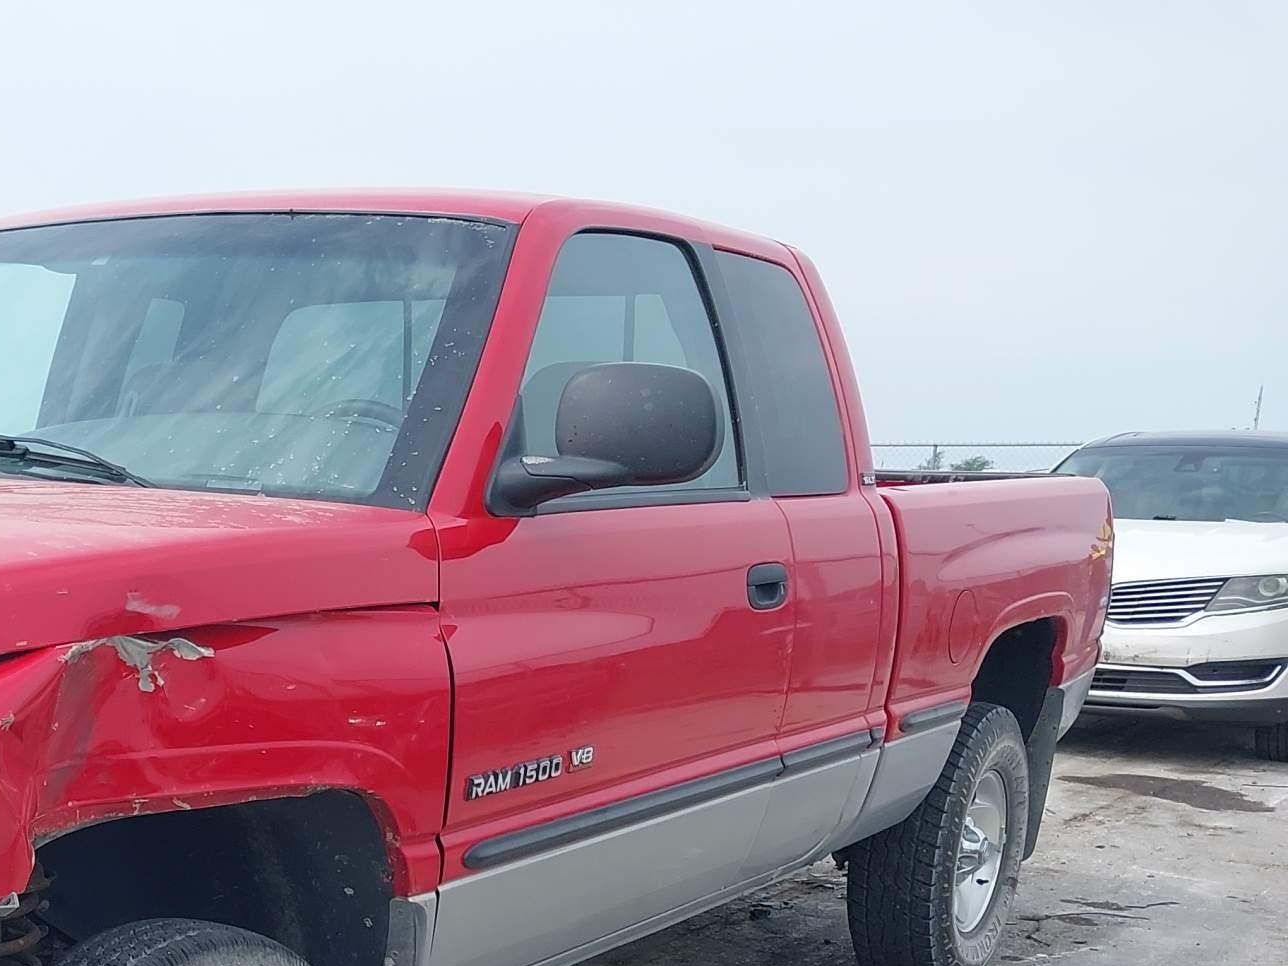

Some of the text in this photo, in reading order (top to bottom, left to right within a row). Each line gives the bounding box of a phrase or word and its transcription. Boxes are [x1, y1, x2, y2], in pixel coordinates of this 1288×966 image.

[472, 747, 593, 799] RAM 1500 V8
